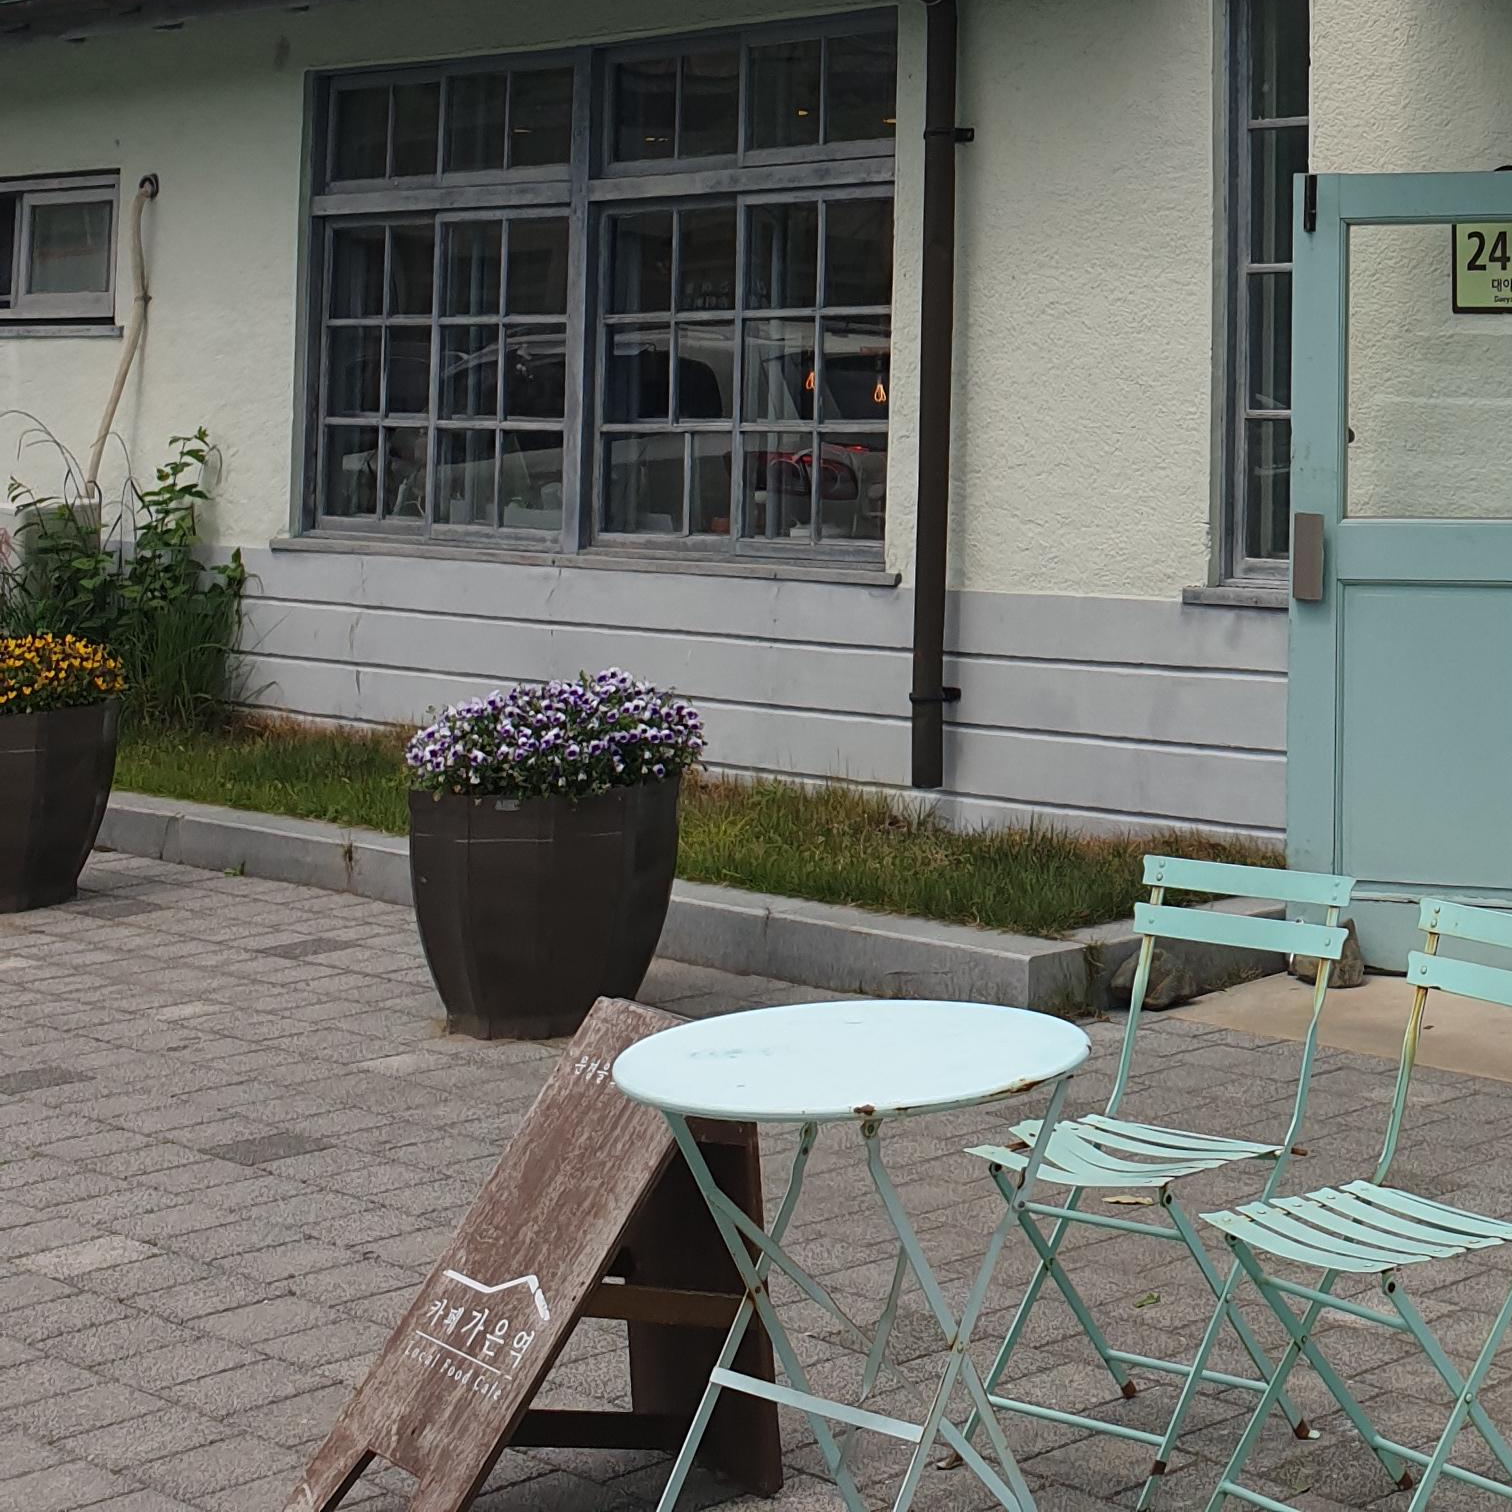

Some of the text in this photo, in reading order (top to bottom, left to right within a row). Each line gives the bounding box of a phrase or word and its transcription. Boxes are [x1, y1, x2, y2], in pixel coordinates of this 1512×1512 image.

[425, 1298, 535, 1369] 카페 가은역
[404, 1340, 502, 1401] Local Food Cafe
